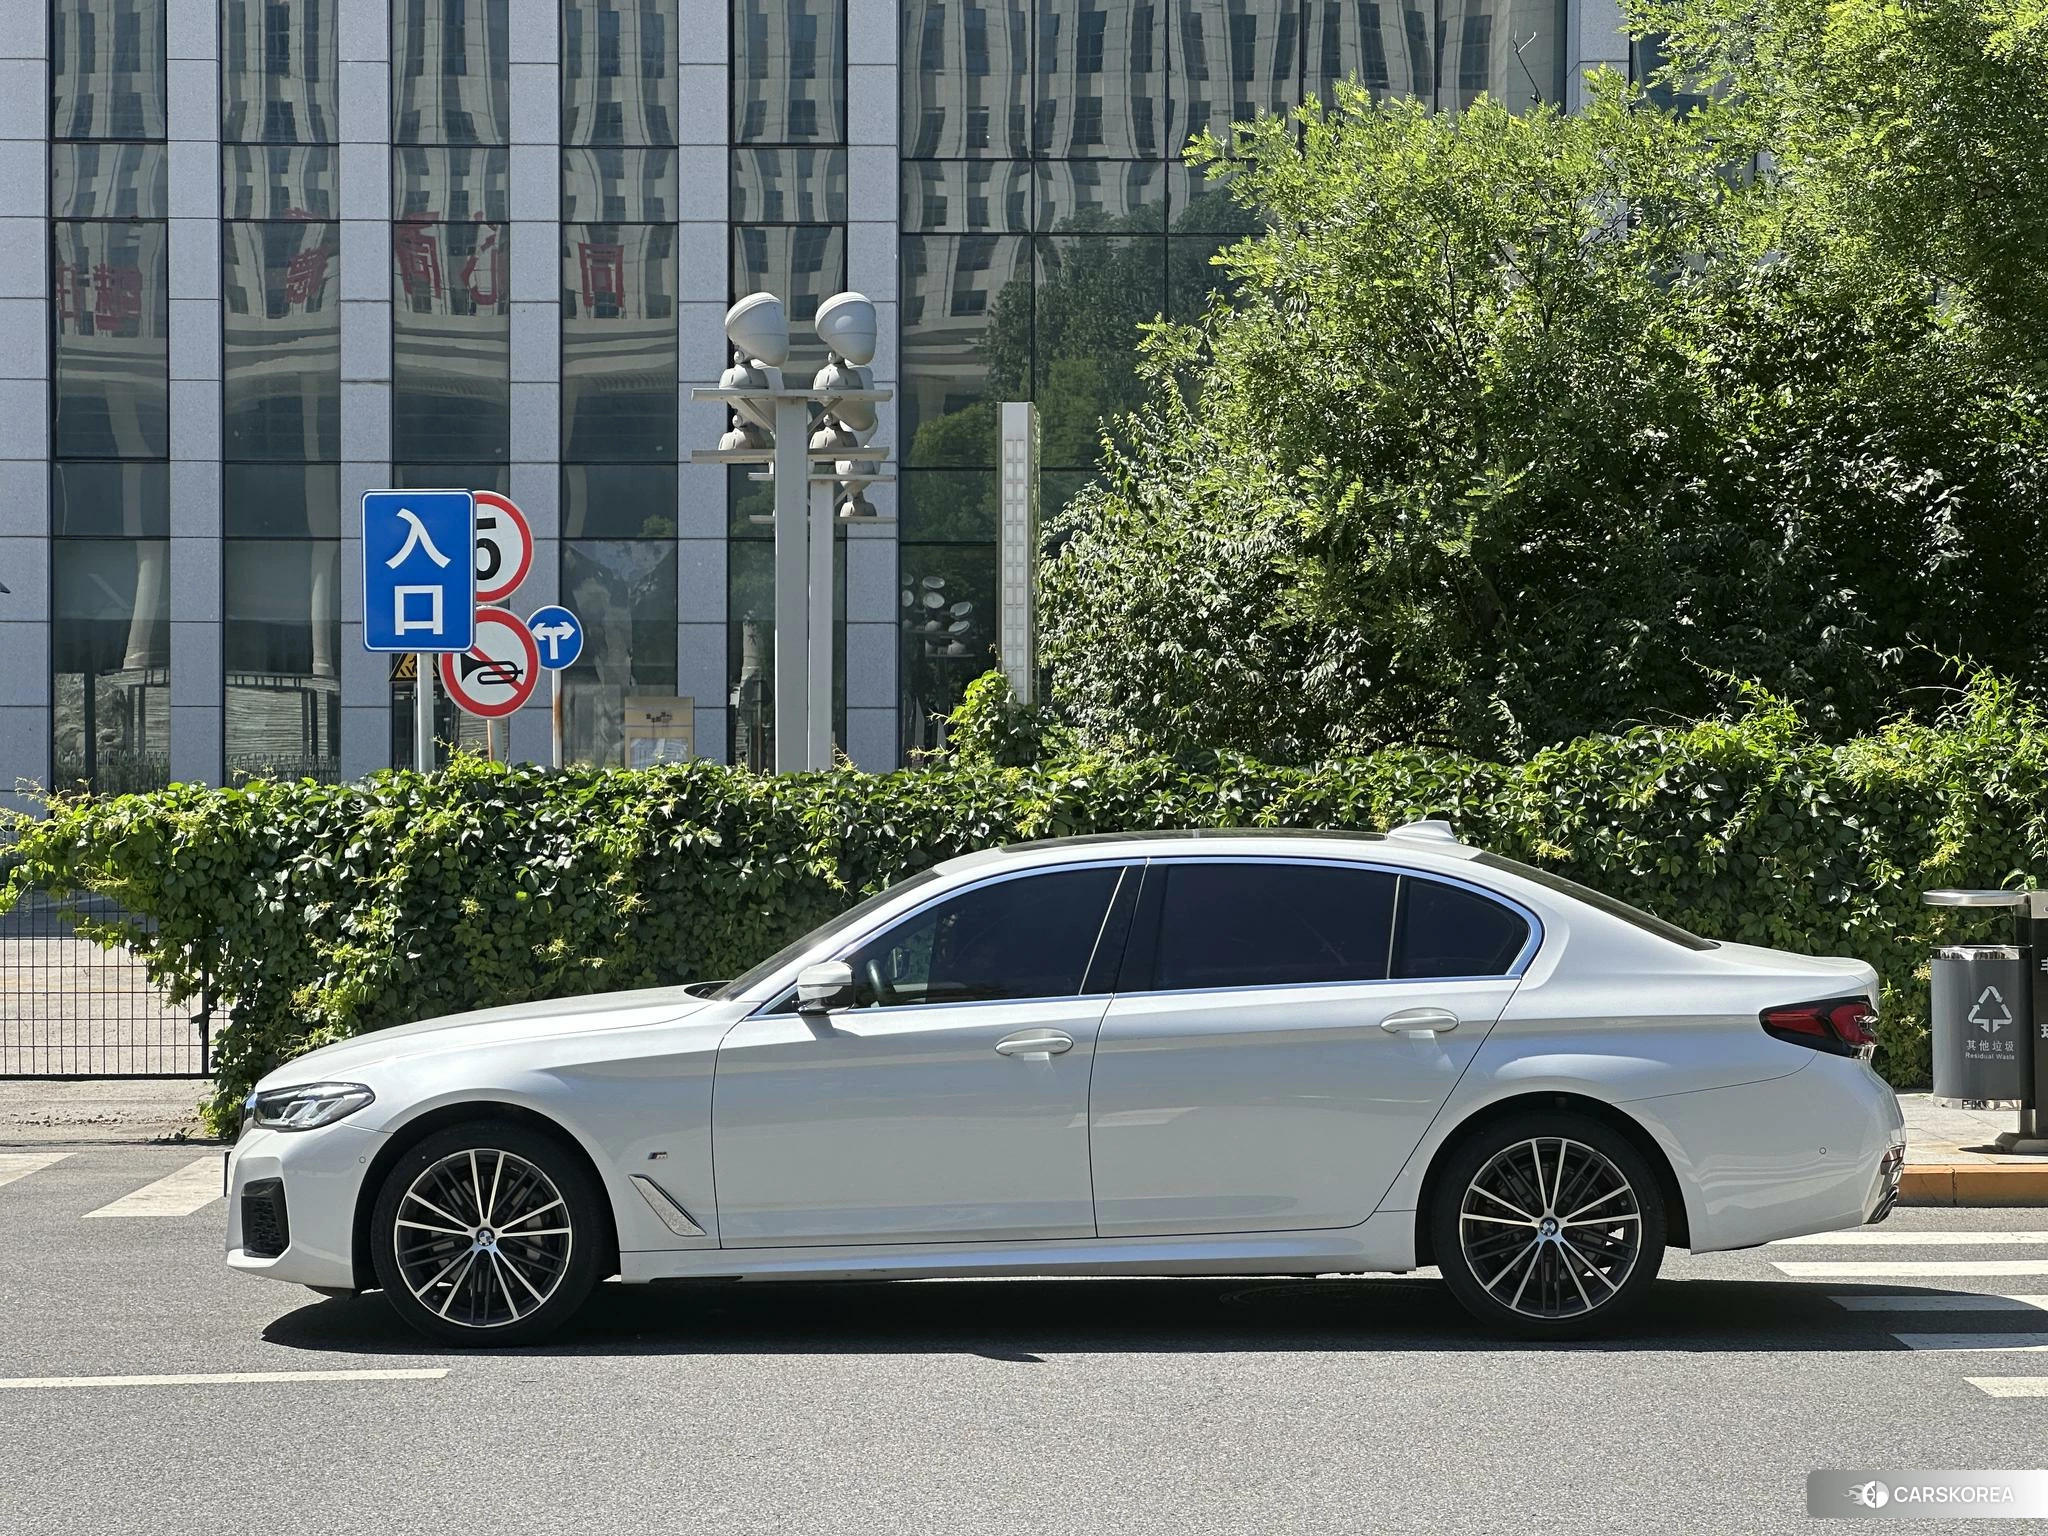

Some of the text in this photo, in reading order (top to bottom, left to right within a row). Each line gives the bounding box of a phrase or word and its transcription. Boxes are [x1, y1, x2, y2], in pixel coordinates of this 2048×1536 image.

[476, 517, 502, 581] 5
[385, 508, 451, 636] 入口
[1965, 1051, 1994, 1060] Residual
[1966, 1039, 2015, 1051] 其他垃圾
